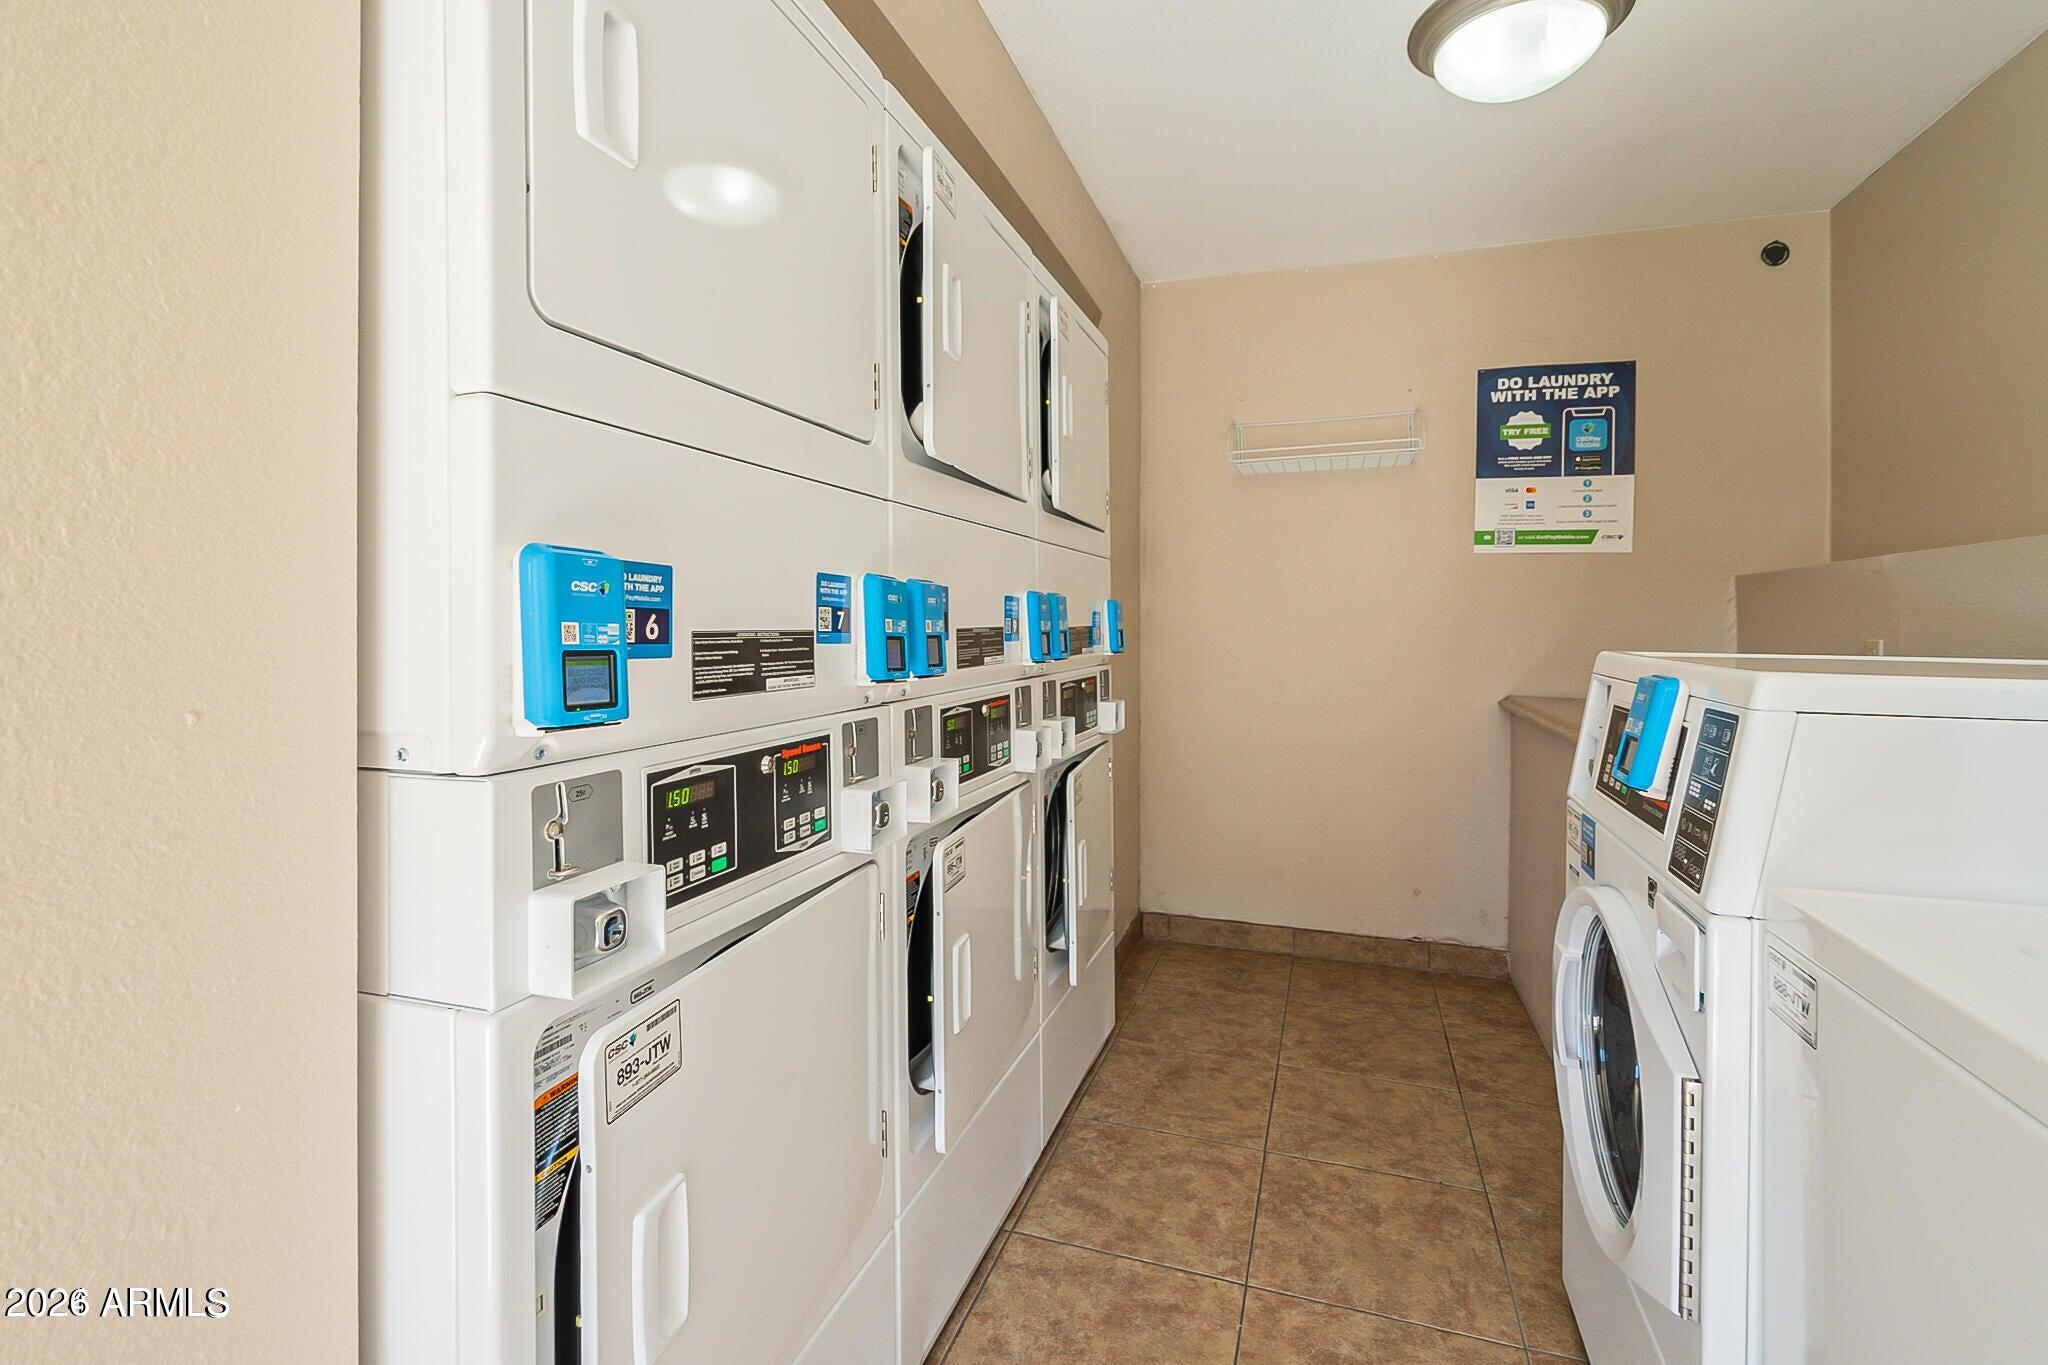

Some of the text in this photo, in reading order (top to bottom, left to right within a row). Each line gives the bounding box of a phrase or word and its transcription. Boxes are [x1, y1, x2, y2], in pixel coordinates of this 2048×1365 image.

[1497, 372, 1615, 390] DO LAUNDRY
[1490, 385, 1621, 403] WITH THE APP
[1502, 427, 1549, 436] TRY FREE
[571, 580, 598, 592] CSC
[628, 573, 662, 584] LAUNDRY
[624, 583, 665, 593] TH THE APP
[645, 613, 659, 640] 6
[837, 611, 845, 630] 7
[607, 1039, 628, 1060] CSC
[616, 1033, 672, 1086] 893-JTW
[549, 1073, 579, 1098] WARNIN
